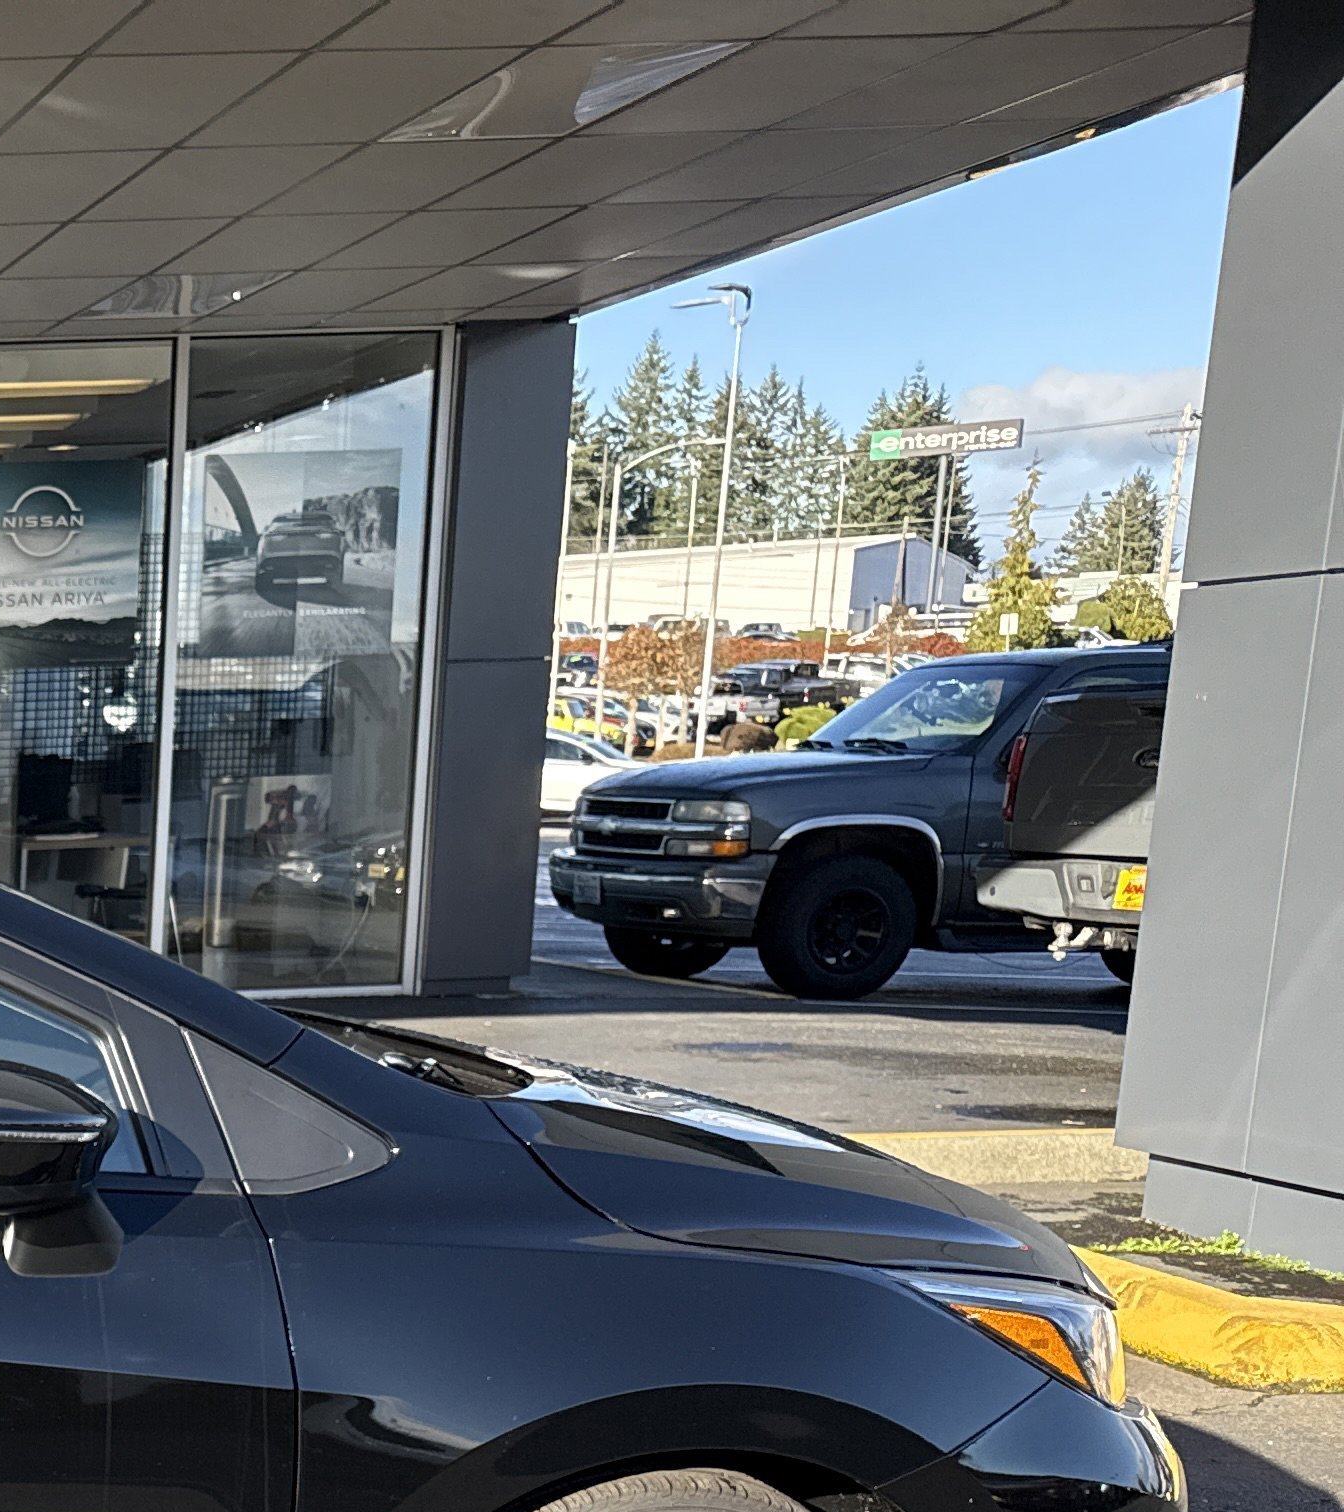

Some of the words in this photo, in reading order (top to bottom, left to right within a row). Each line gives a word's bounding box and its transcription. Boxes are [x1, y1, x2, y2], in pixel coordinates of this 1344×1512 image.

[879, 425, 1019, 452] enterprise
[2, 515, 85, 528] NISSAN
[42, 576, 116, 587] ALL-ELECTRIC
[50, 590, 106, 606] ARIYA
